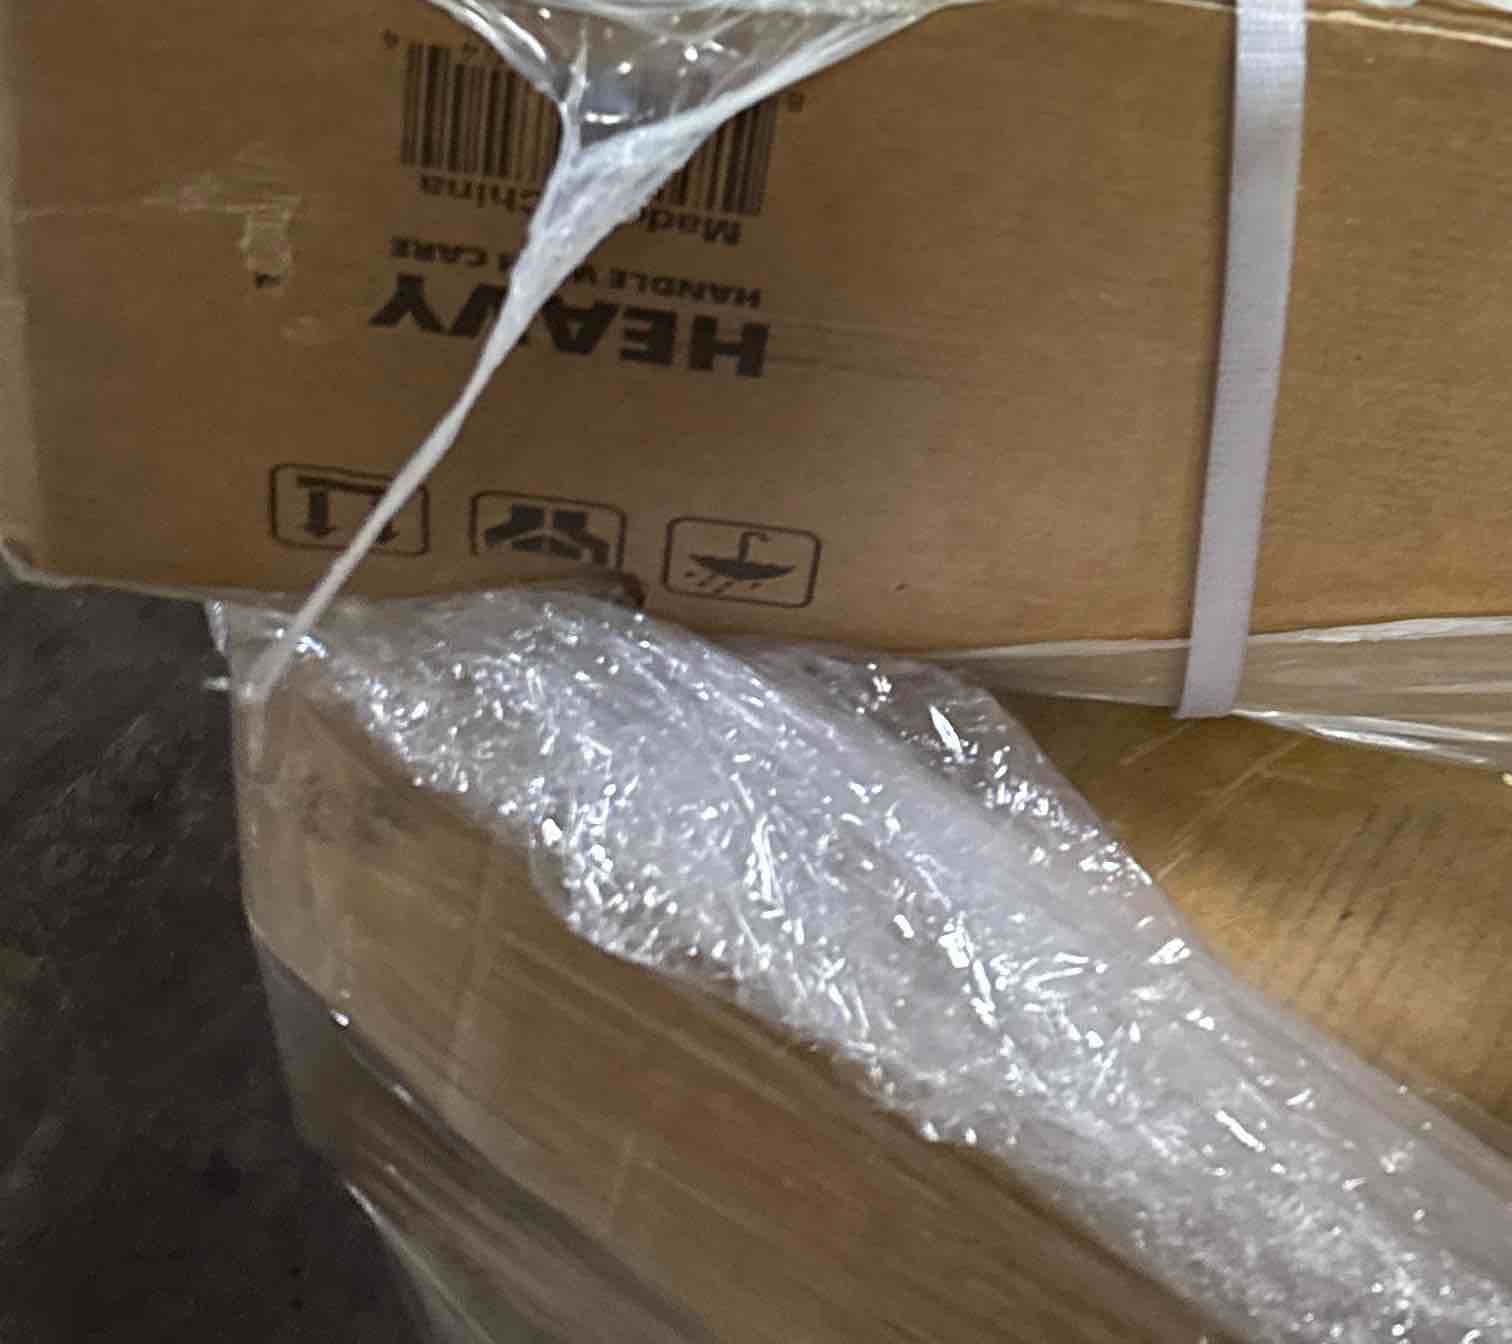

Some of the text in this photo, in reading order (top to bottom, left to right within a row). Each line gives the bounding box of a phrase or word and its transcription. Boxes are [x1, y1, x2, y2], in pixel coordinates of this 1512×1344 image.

[391, 238, 488, 268] CARE
[609, 266, 761, 309] HANDLE
[368, 273, 769, 378] HEAVY
